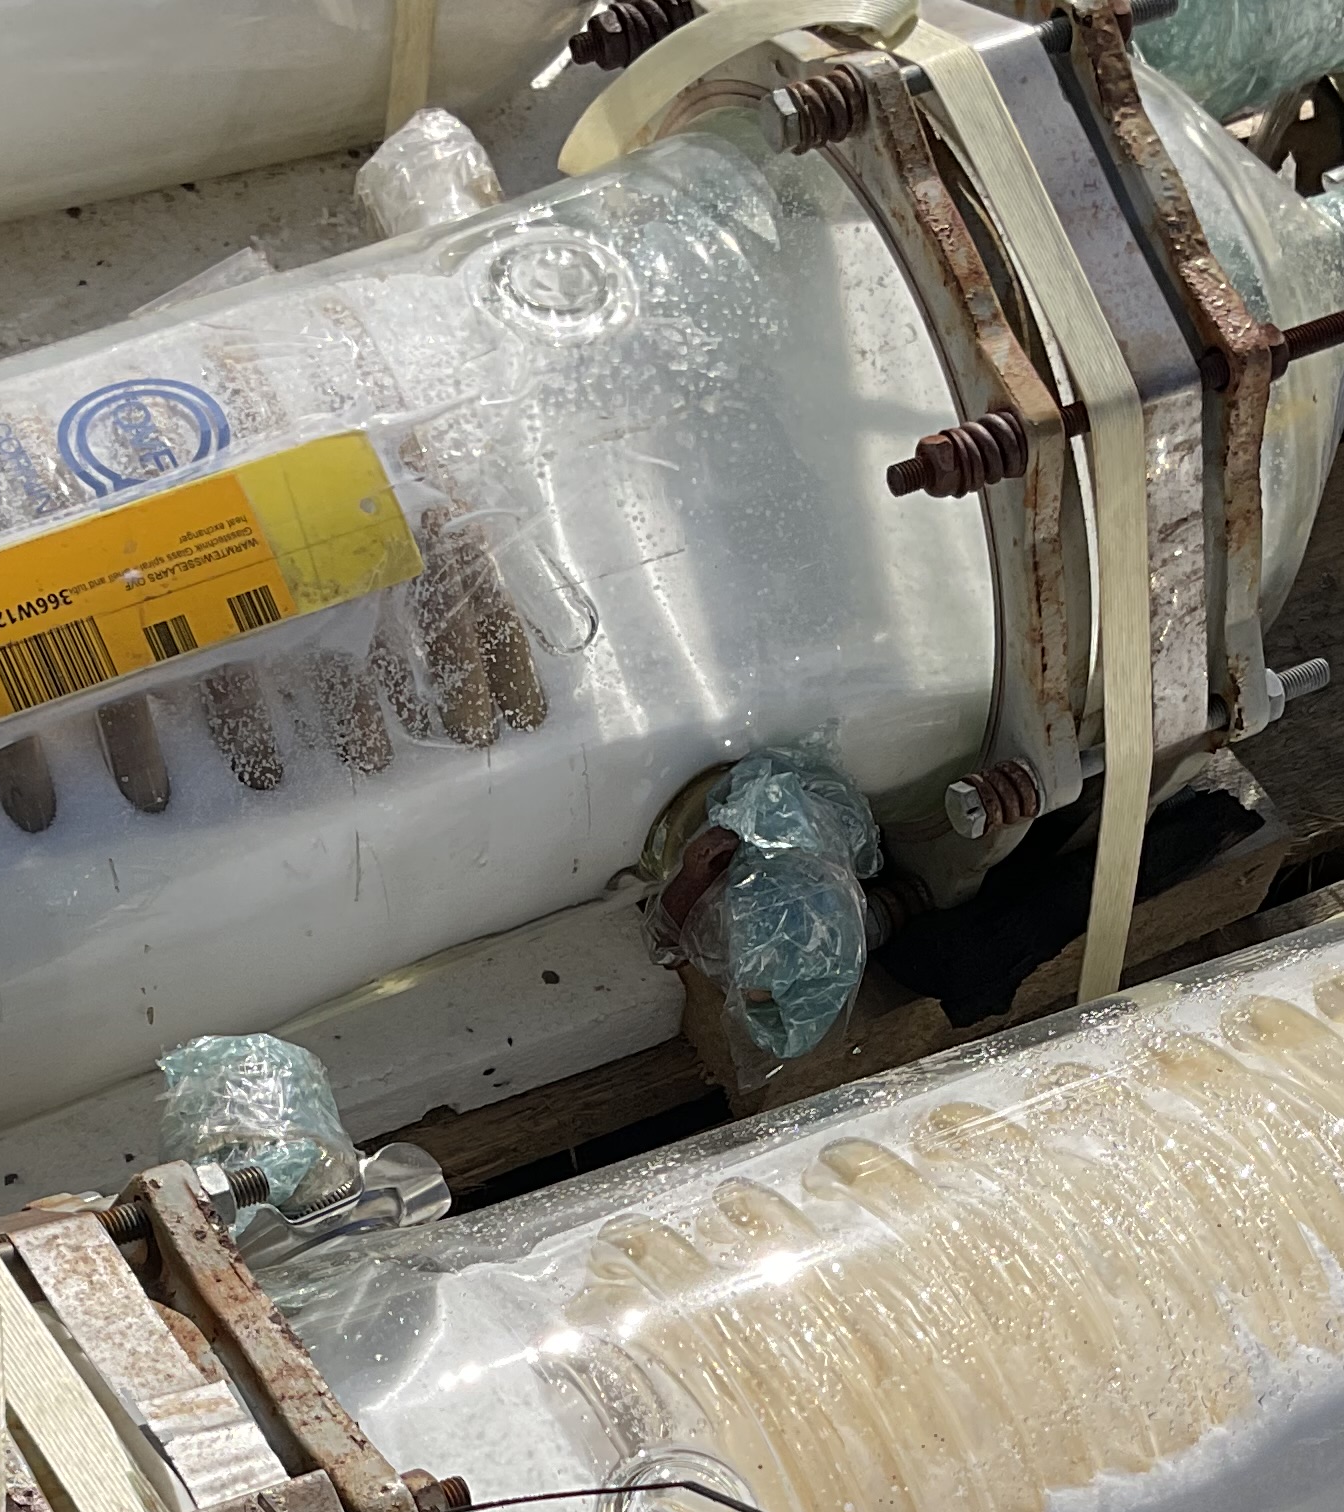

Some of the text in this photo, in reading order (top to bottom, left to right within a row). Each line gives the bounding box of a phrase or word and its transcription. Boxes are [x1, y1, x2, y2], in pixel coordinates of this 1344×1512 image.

[177, 513, 248, 545] heat exchanger
[193, 525, 253, 555] Glasstechnik
[147, 537, 259, 584] WARMTEWISSELAARS
[165, 545, 194, 564] Glass
[86, 575, 106, 591] and
